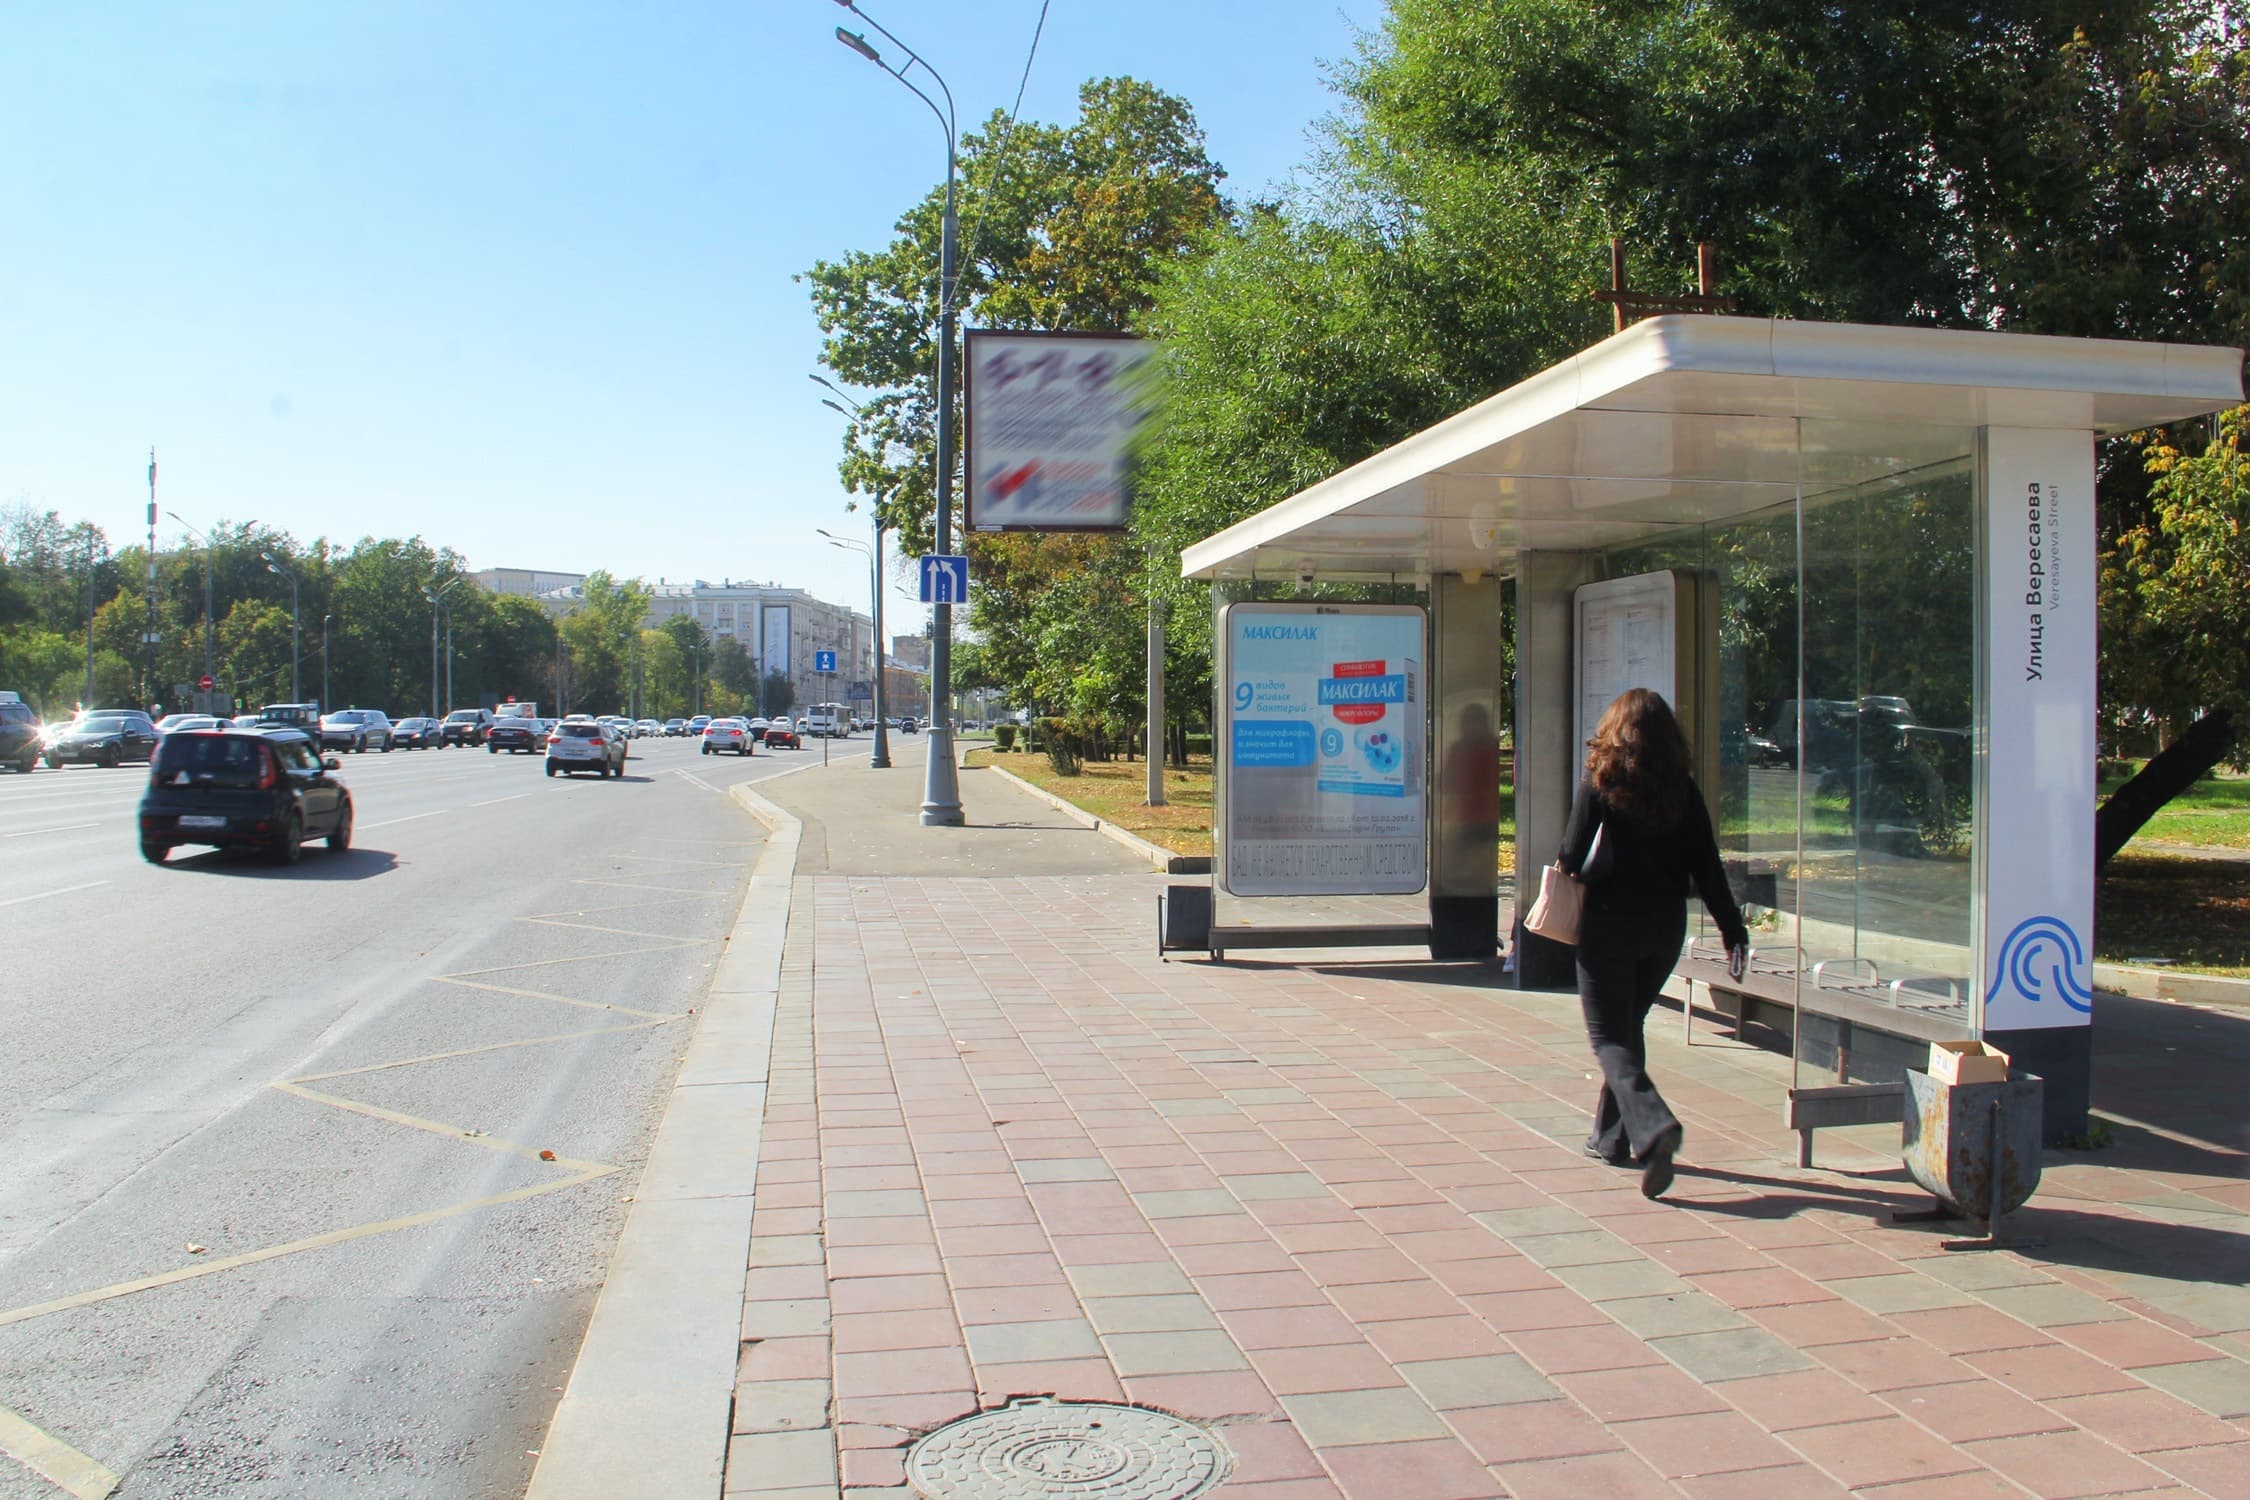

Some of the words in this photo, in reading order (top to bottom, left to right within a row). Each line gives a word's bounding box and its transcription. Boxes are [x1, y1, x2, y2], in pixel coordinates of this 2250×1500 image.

[2047, 485, 2059, 526] Street
[2026, 482, 2045, 605] Вересаева
[2049, 531, 2061, 610] Veresayeva
[1242, 624, 1318, 640] МАКСИЛАК
[2026, 614, 2044, 682] Улица
[1256, 680, 1286, 690] видов
[1322, 681, 1397, 700] МАКСИЛАК
[1234, 681, 1254, 711] 9
[1256, 693, 1291, 701] живых
[1256, 703, 1307, 713] бактерий
[1327, 734, 1337, 752] 9
